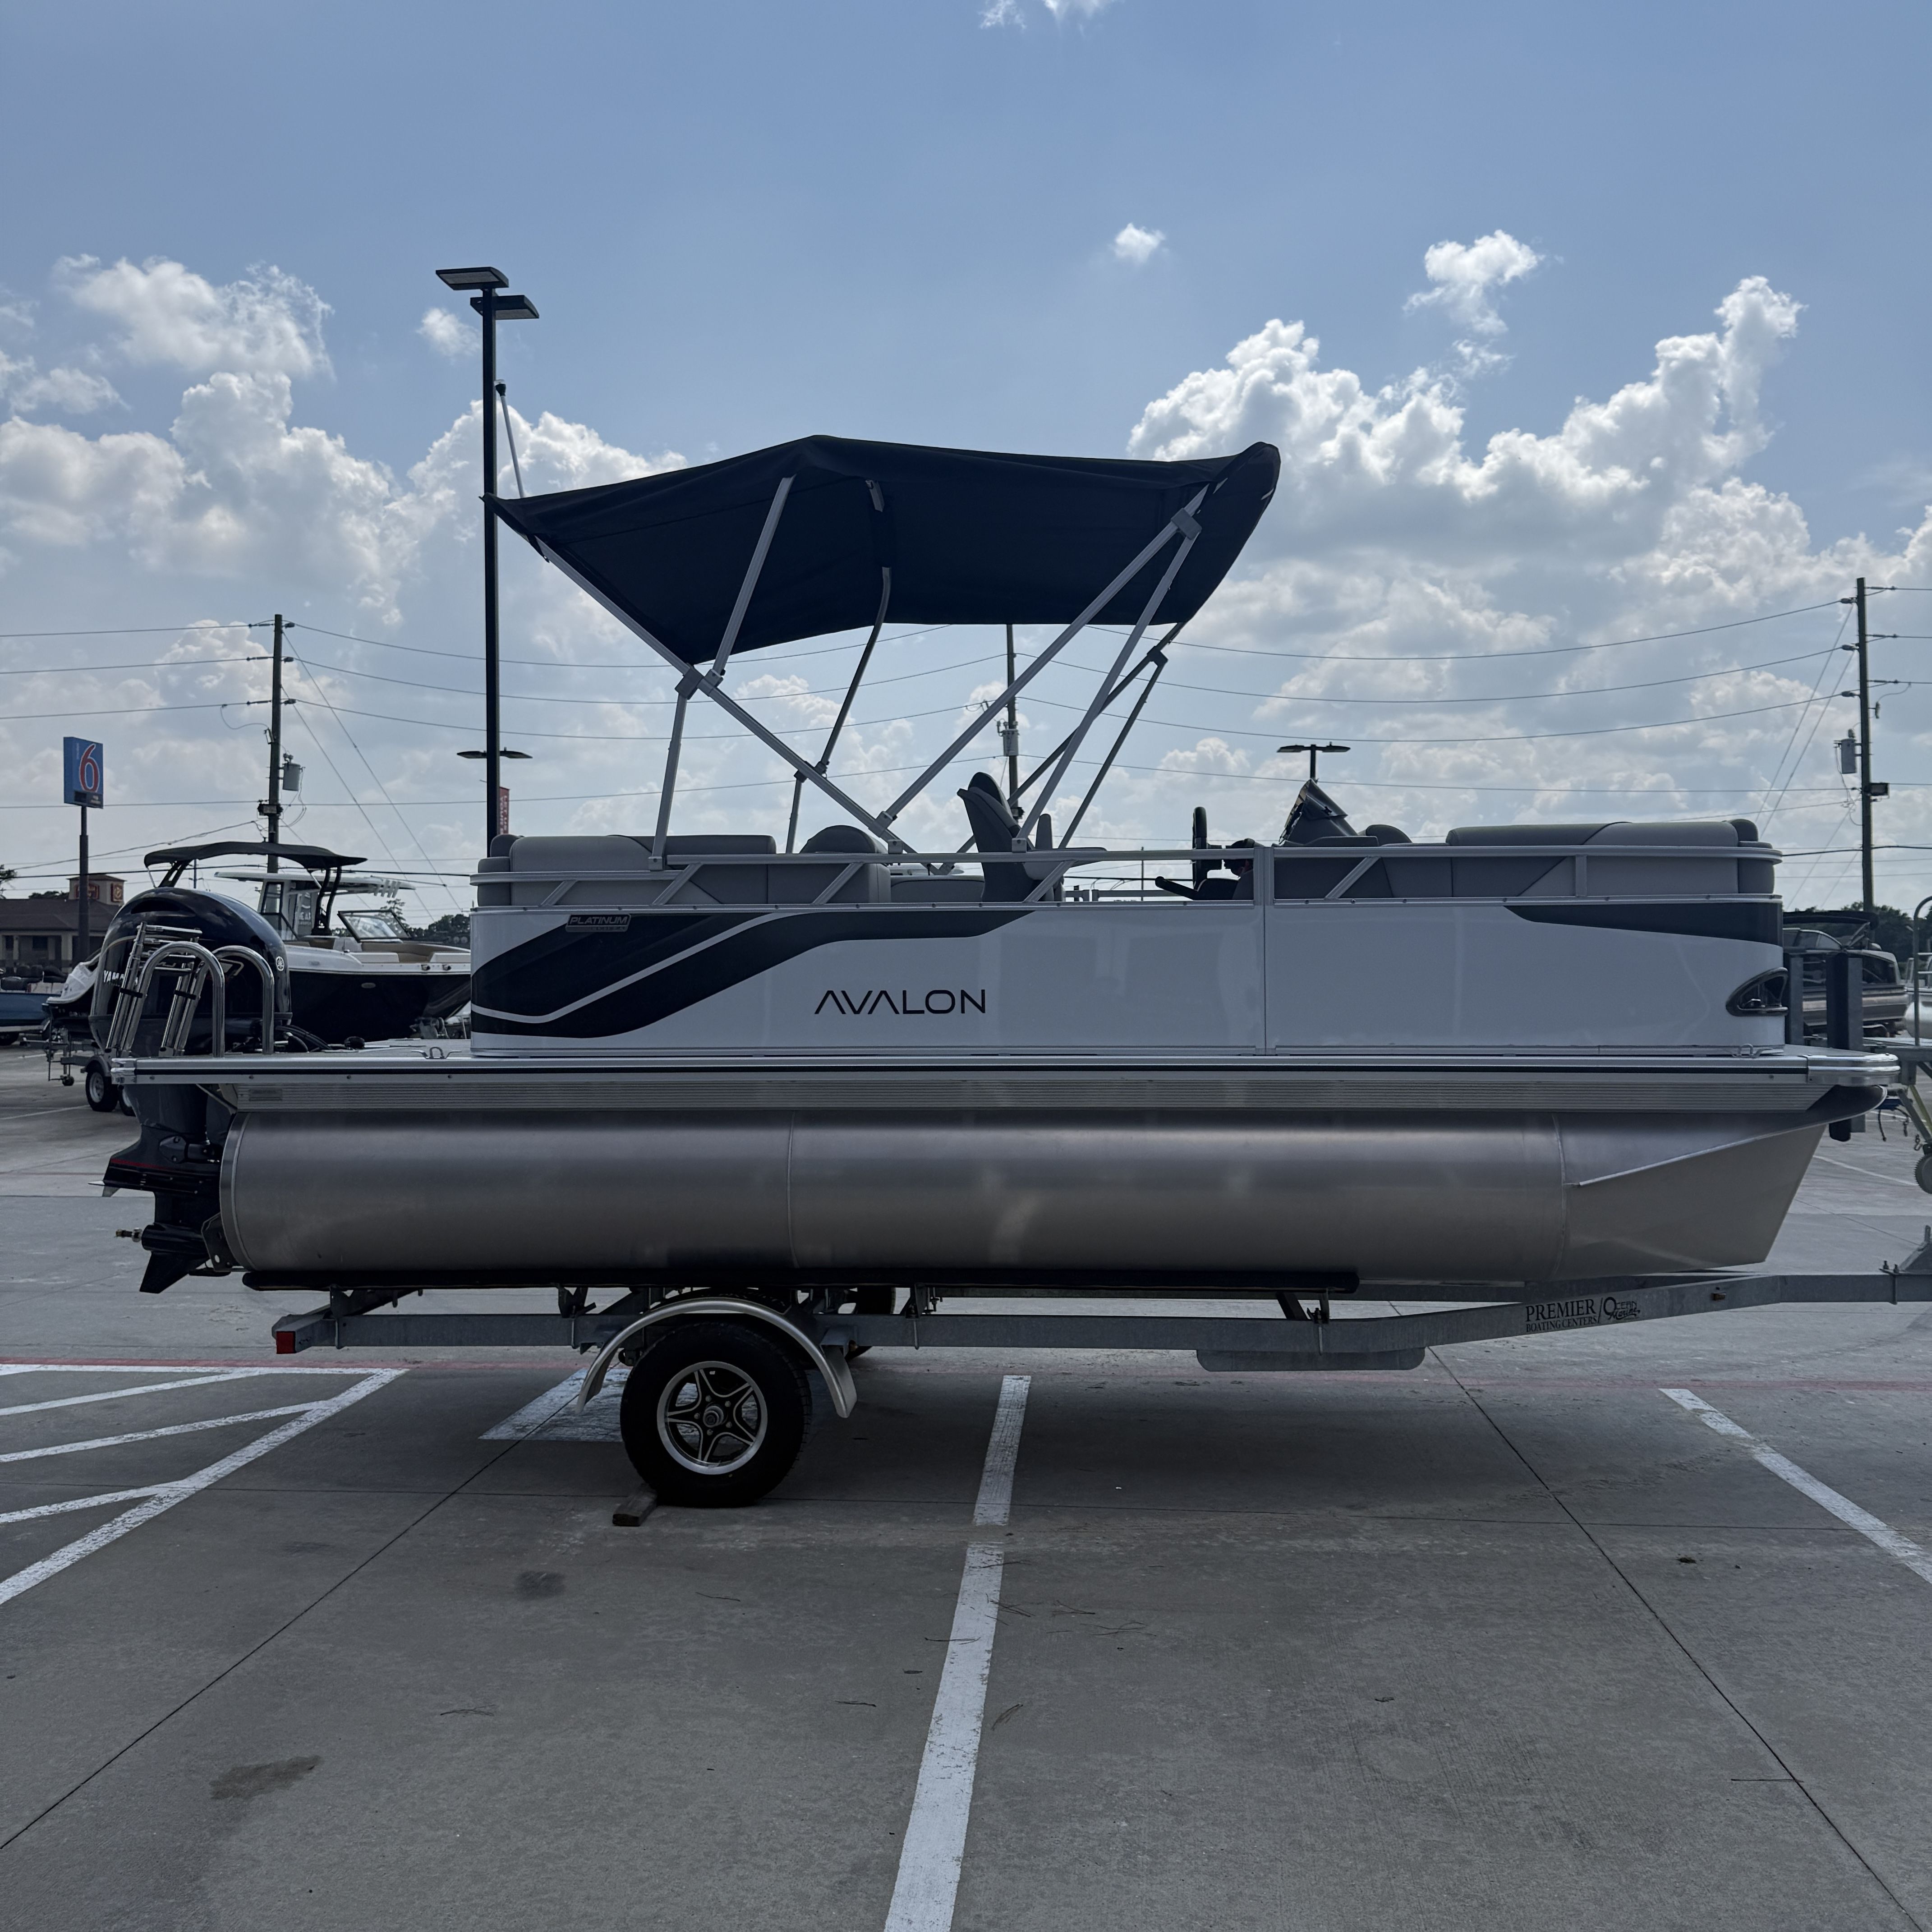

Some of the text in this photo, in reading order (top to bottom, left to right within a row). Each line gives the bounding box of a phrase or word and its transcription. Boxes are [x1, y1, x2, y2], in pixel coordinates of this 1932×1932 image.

[79, 744, 100, 792] 6
[814, 989, 985, 1014] AVALON
[1525, 1299, 1596, 1322] PREMIER
[1526, 1316, 1597, 1333] BOATING CENTERS
